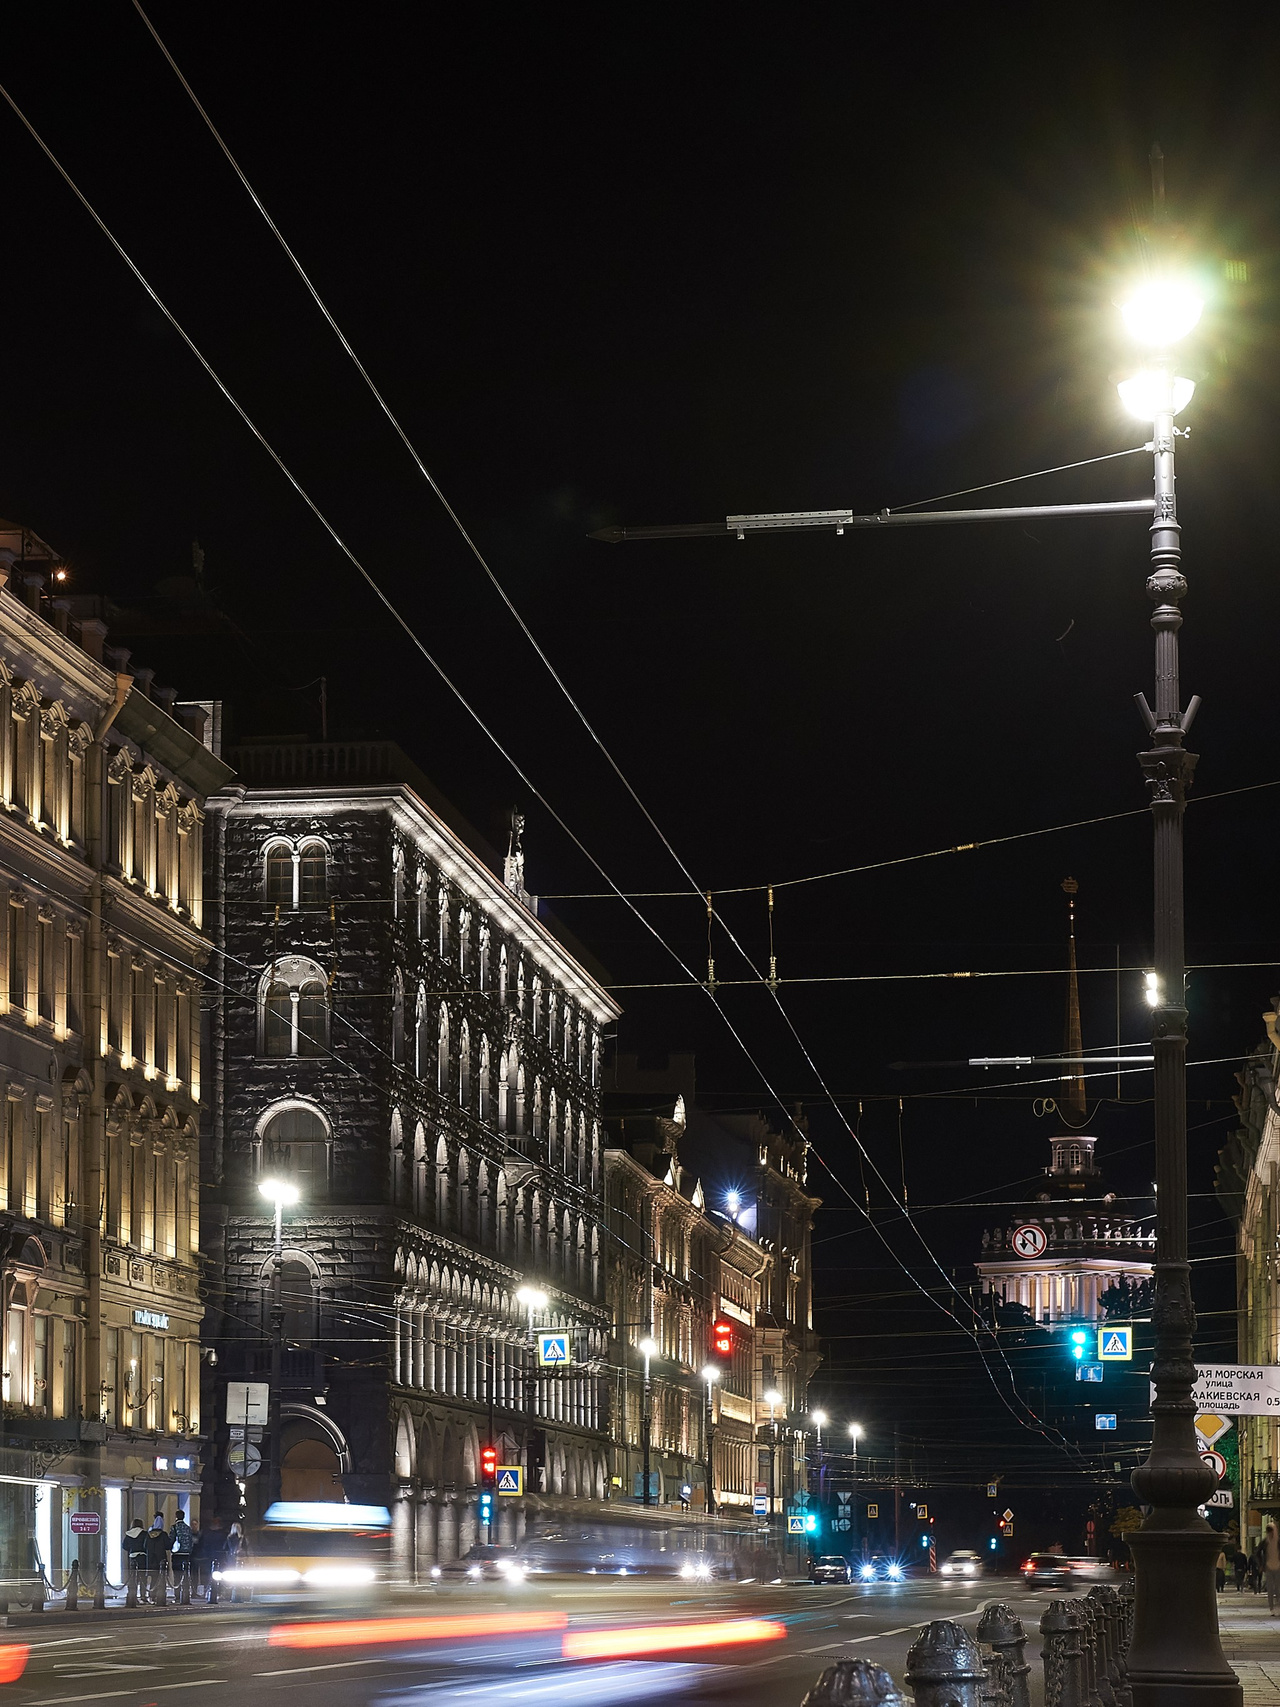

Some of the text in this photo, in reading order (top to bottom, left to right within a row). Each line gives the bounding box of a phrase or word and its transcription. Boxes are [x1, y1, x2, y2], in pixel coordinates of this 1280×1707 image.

[1214, 1370, 1263, 1380] МОРСКАЯ
[1205, 1380, 1233, 1389] улица
[1192, 1391, 1260, 1401] ААКИЕВСКАЯ
[1199, 1401, 1240, 1410] площадь
